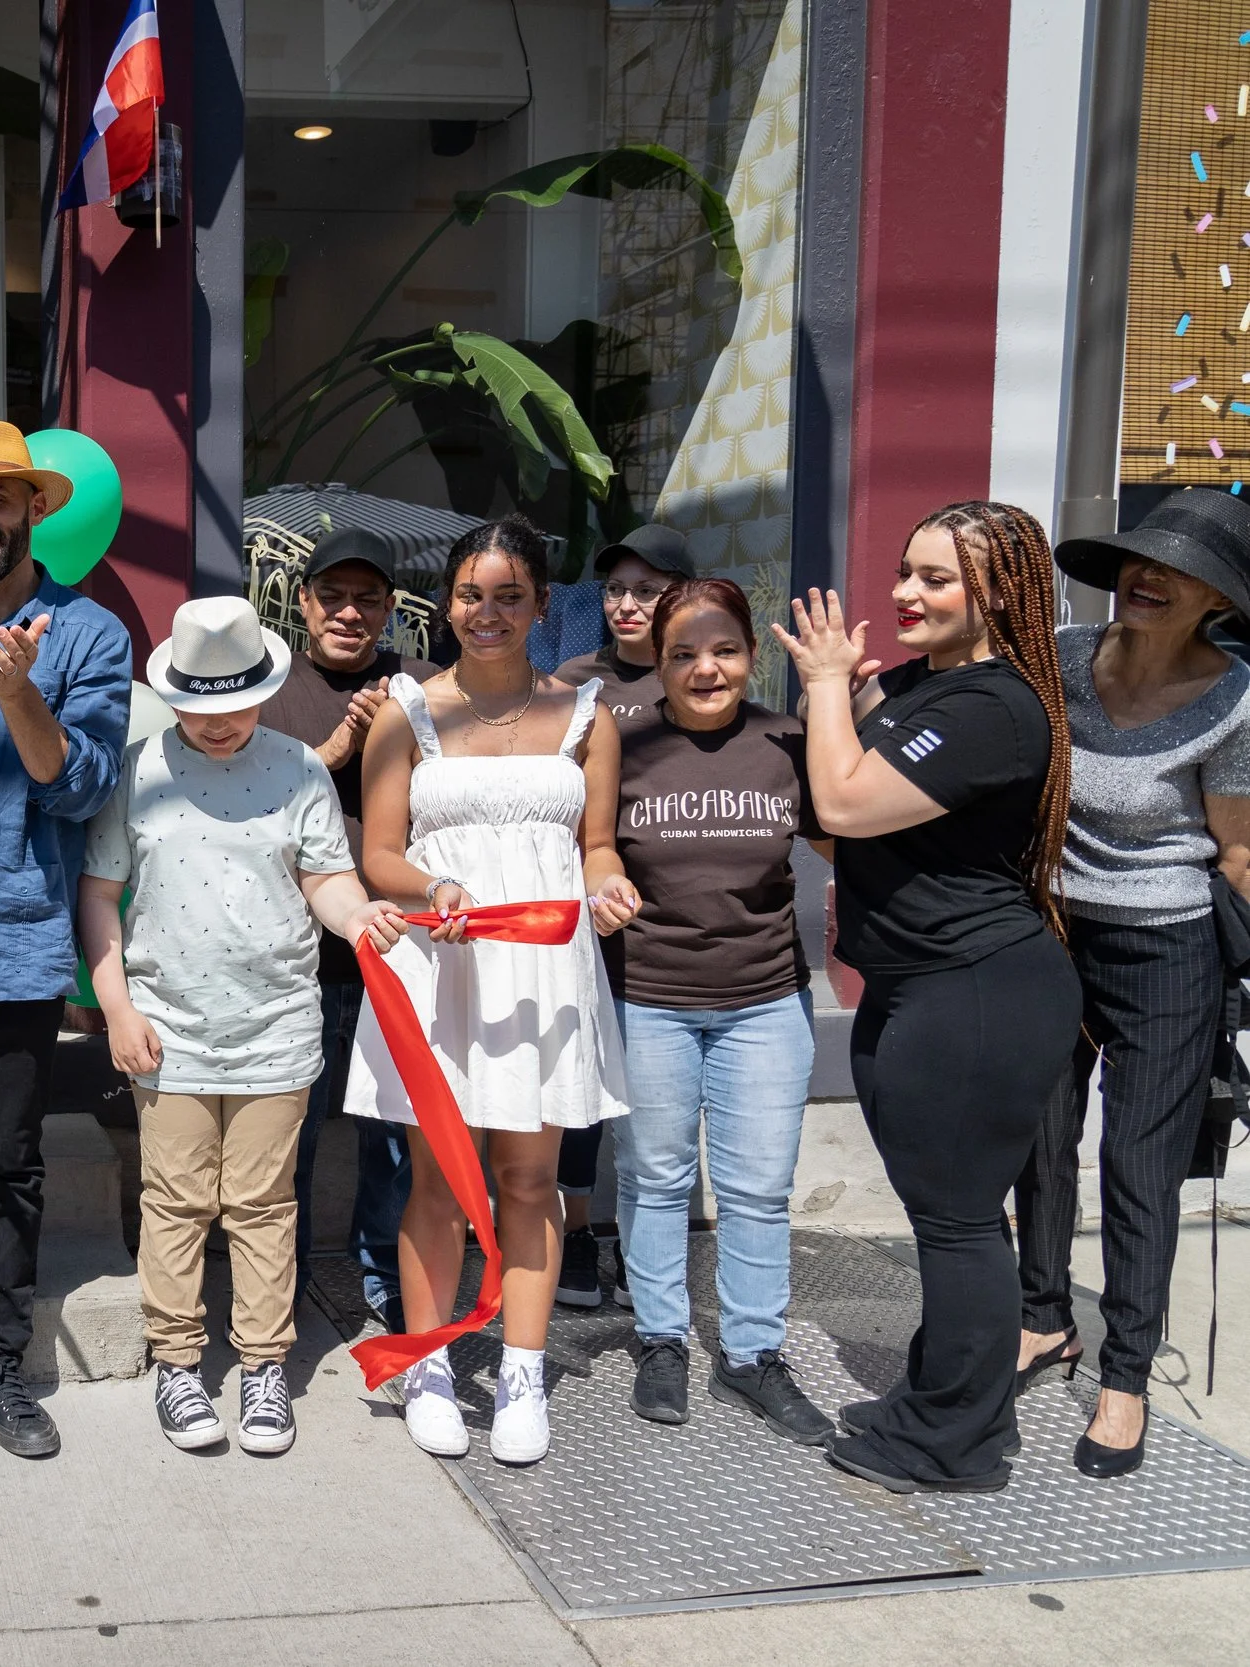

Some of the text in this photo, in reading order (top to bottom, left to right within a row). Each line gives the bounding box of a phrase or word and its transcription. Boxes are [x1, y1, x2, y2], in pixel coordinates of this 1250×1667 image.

[630, 789, 793, 828] CHACABANAS
[661, 829, 773, 838] CUBAN SANDWICHES
